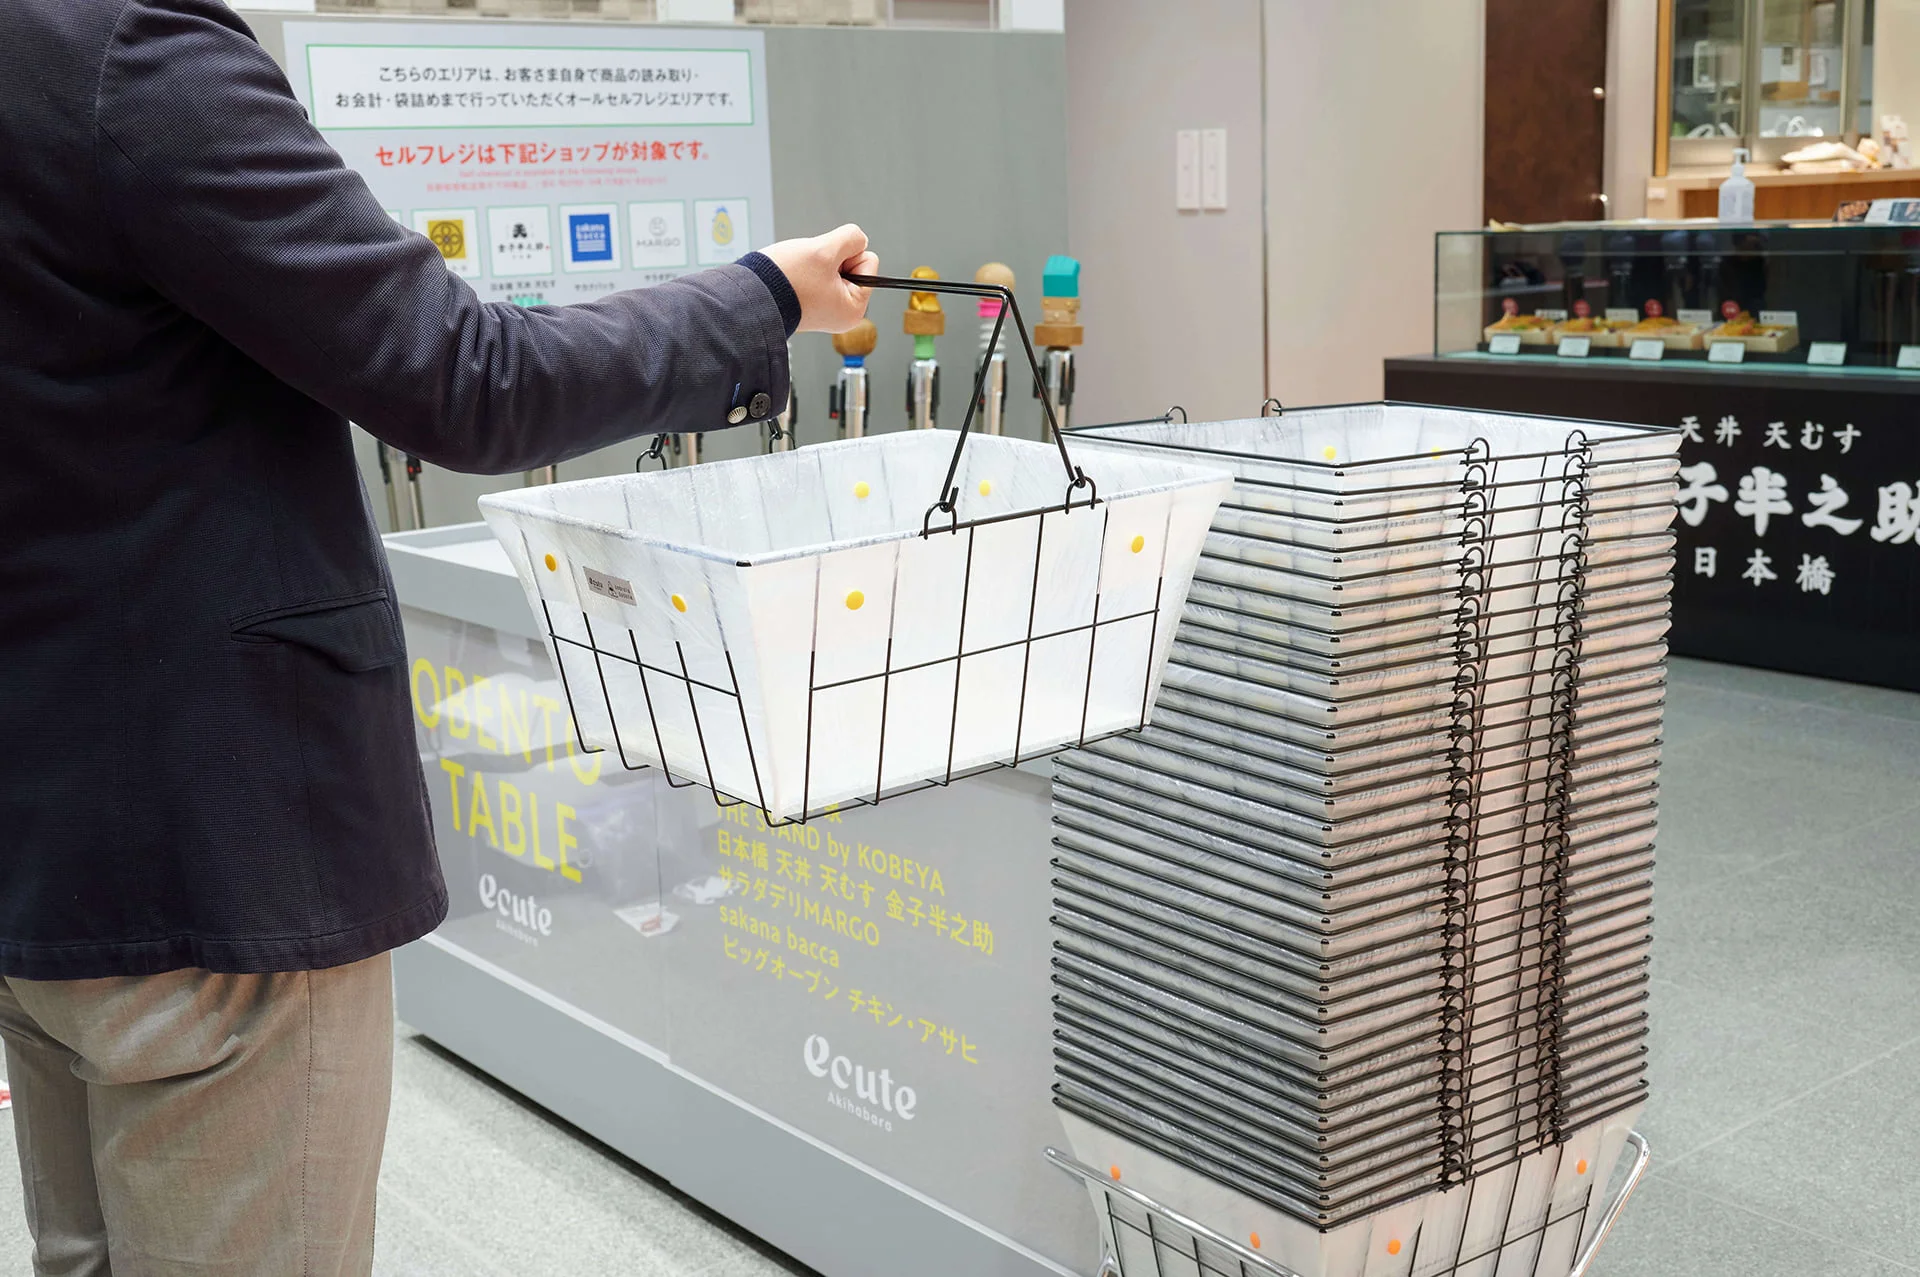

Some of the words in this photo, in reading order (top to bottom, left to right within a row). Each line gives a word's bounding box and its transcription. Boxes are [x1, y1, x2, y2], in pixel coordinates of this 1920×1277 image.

[376, 141, 709, 166] セルフレジは下記ショップが対象です。
[1763, 421, 1862, 454] 天むす
[1694, 546, 1836, 596] 日本橋
[440, 757, 582, 884] TABLE
[718, 829, 769, 872] 日本橋
[819, 863, 875, 909] 天むす
[885, 889, 994, 955] 金子半之助
[827, 832, 850, 868] by
[857, 843, 945, 897] KOBEYA
[479, 873, 553, 937] ecute
[719, 904, 782, 944] sakana
[787, 925, 840, 969] bacca
[803, 1033, 917, 1122] ecute
[826, 1090, 894, 1133] Akihabara
